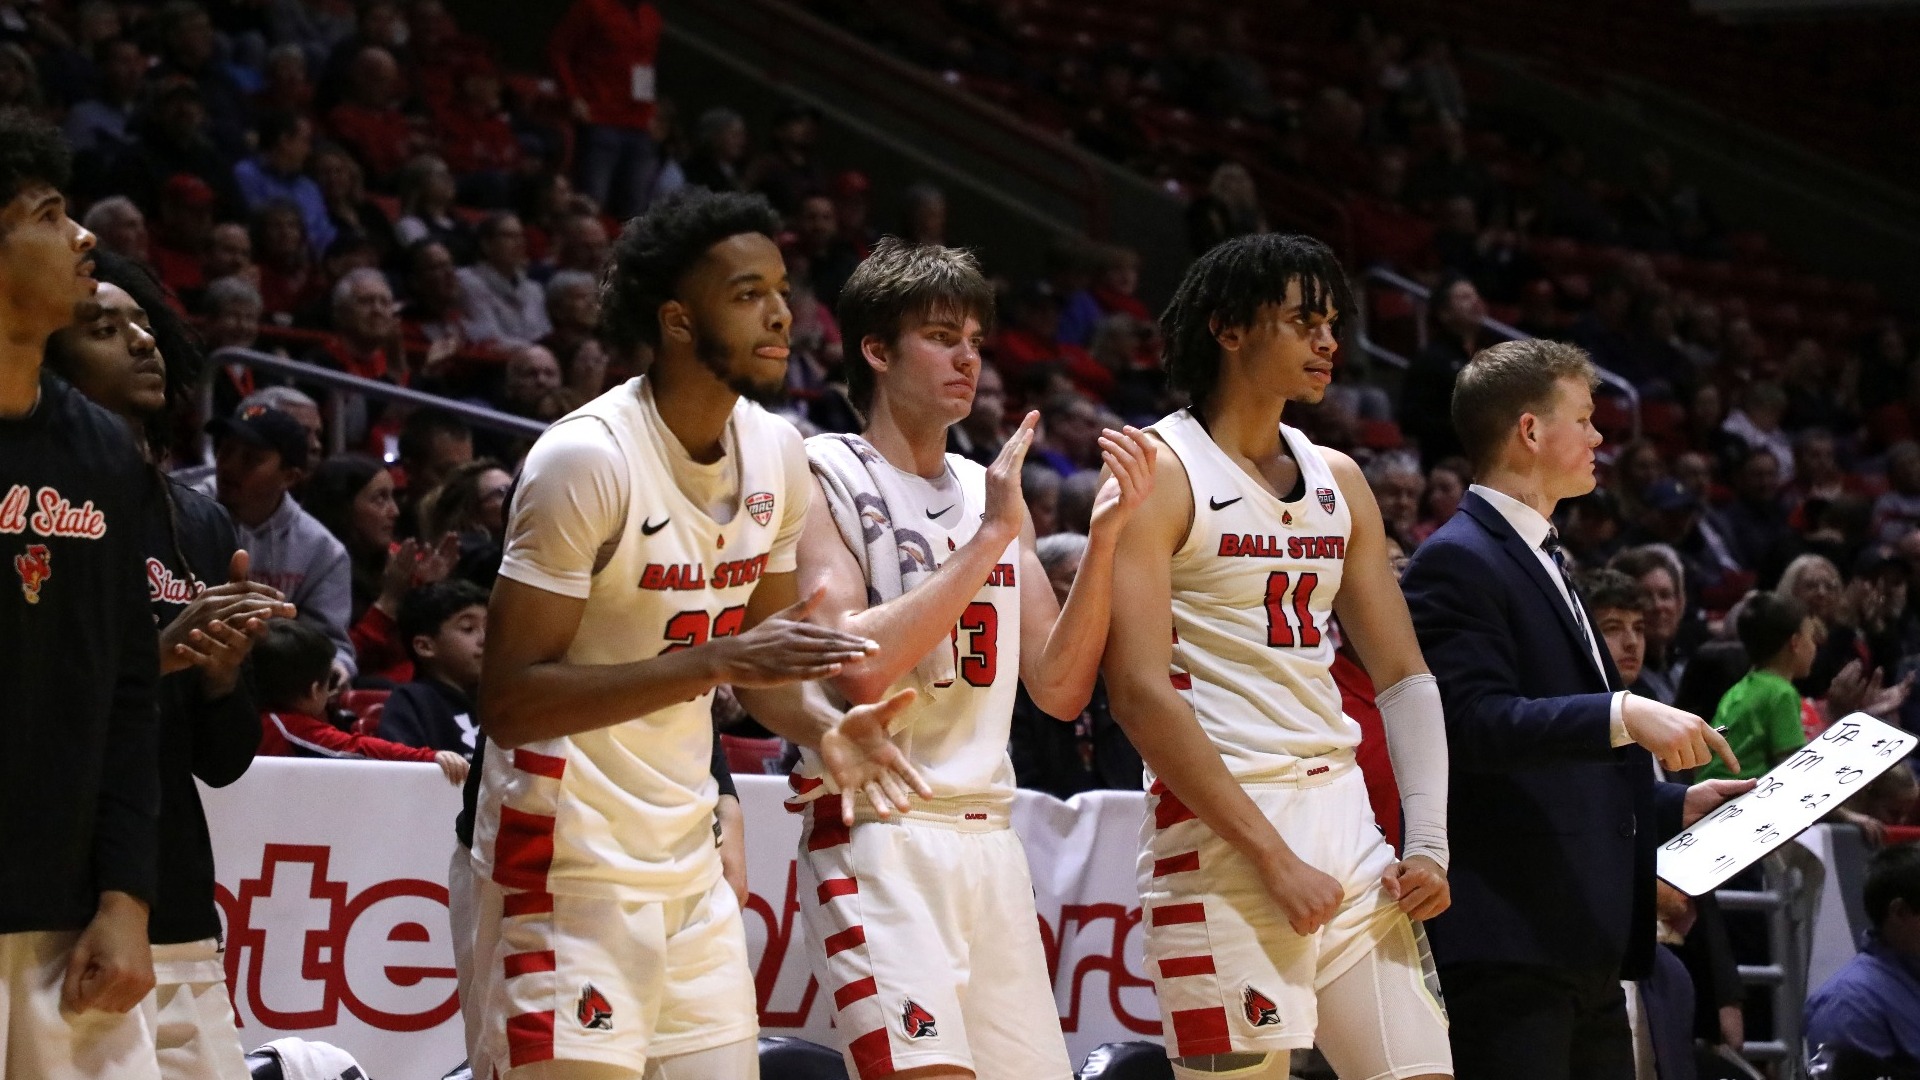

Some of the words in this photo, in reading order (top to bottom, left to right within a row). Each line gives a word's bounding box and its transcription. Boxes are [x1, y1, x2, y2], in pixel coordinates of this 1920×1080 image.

[30, 486, 107, 539] State
[748, 500, 774, 514] MAC
[1217, 533, 1283, 558] BALL
[638, 563, 706, 590] BALL
[1263, 570, 1321, 648] 11
[1822, 722, 1861, 747] JA
[1871, 738, 1904, 758] #12
[1786, 748, 1825, 773] TM
[1835, 765, 1864, 785] #0
[1800, 793, 1831, 809] #2
[1709, 804, 1744, 824] MP
[1752, 822, 1780, 844] #10
